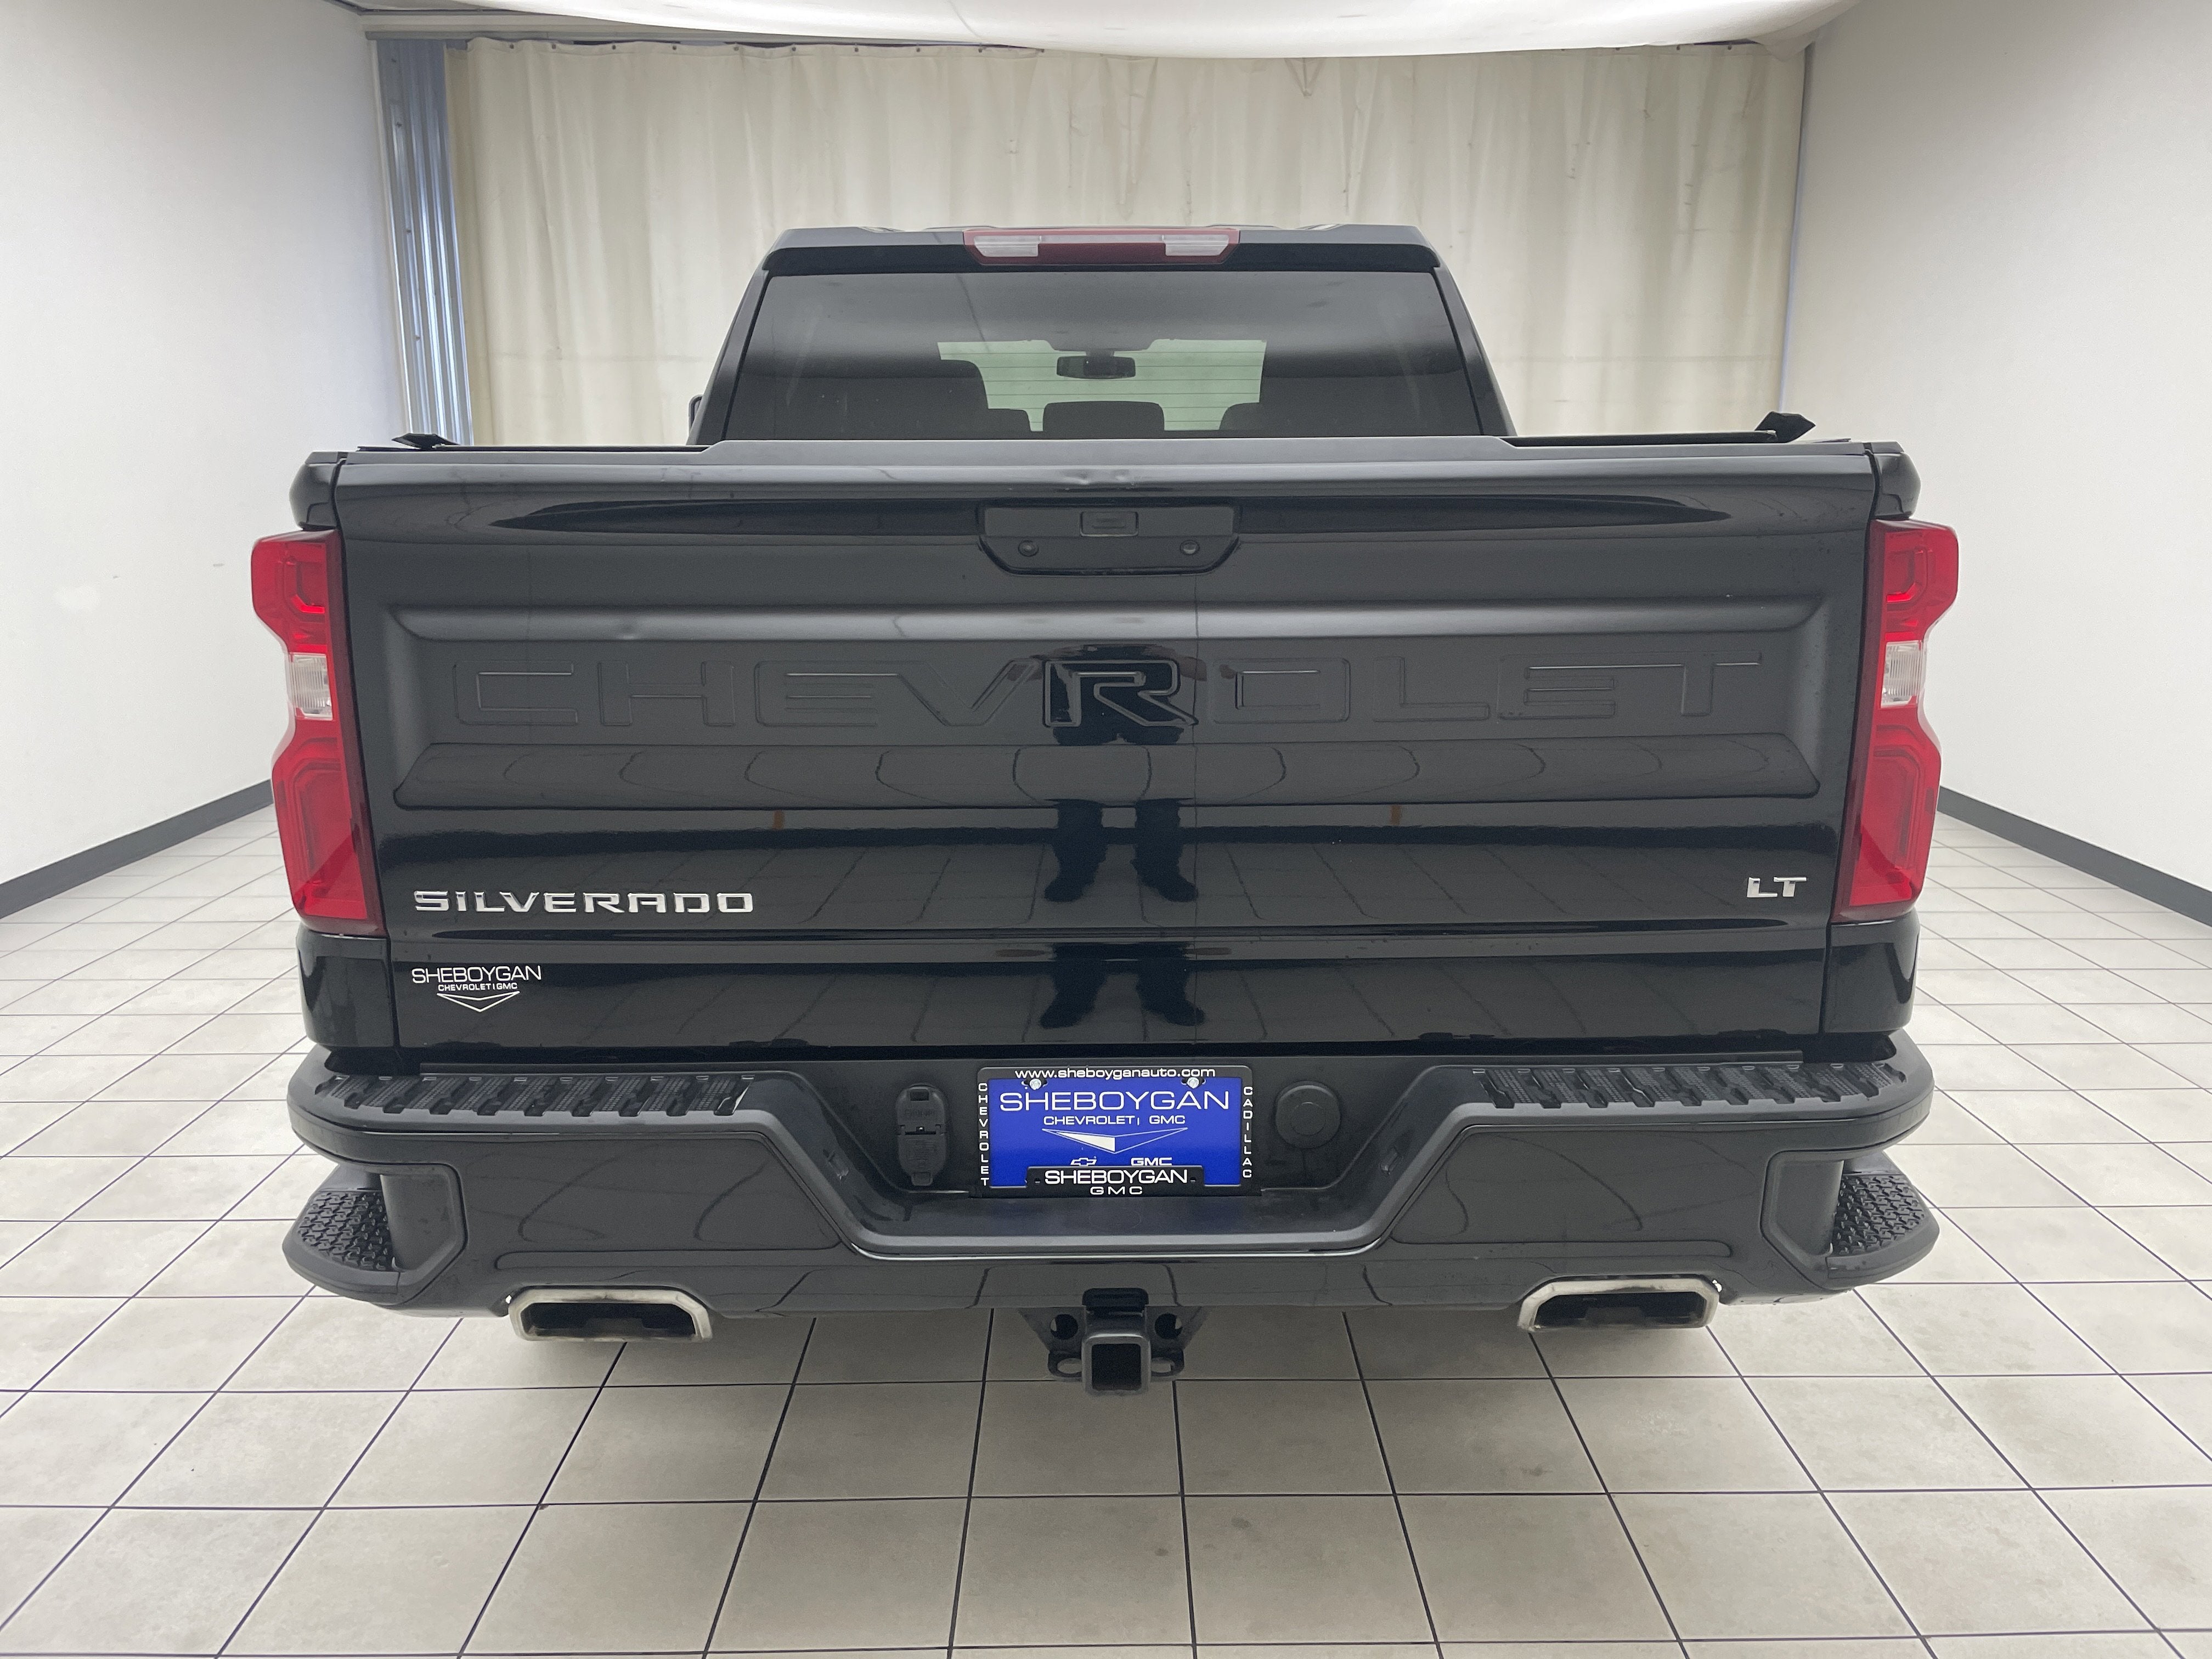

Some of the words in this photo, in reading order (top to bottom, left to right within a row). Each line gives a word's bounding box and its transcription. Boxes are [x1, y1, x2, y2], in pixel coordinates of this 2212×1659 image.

[1746, 877, 1807, 898] LT
[414, 890, 754, 913] SILVERADO
[411, 965, 541, 984] SHEBOYGAN
[438, 983, 490, 991] CHEVROLET
[496, 982, 518, 990] GMC
[1014, 1067, 1216, 1080] www.sheboyganauto.com
[999, 1091, 1229, 1111] SHEBOYGAN
[1043, 1115, 1136, 1125] CHEVROLET
[1149, 1115, 1186, 1125] GMC
[978, 1082, 990, 1187] CHEVROLET
[1242, 1086, 1254, 1178] CADILLAC
[1130, 1157, 1172, 1166] GMC
[1044, 1169, 1188, 1185] SHEBOYGAN
[1090, 1186, 1143, 1195] GMC
